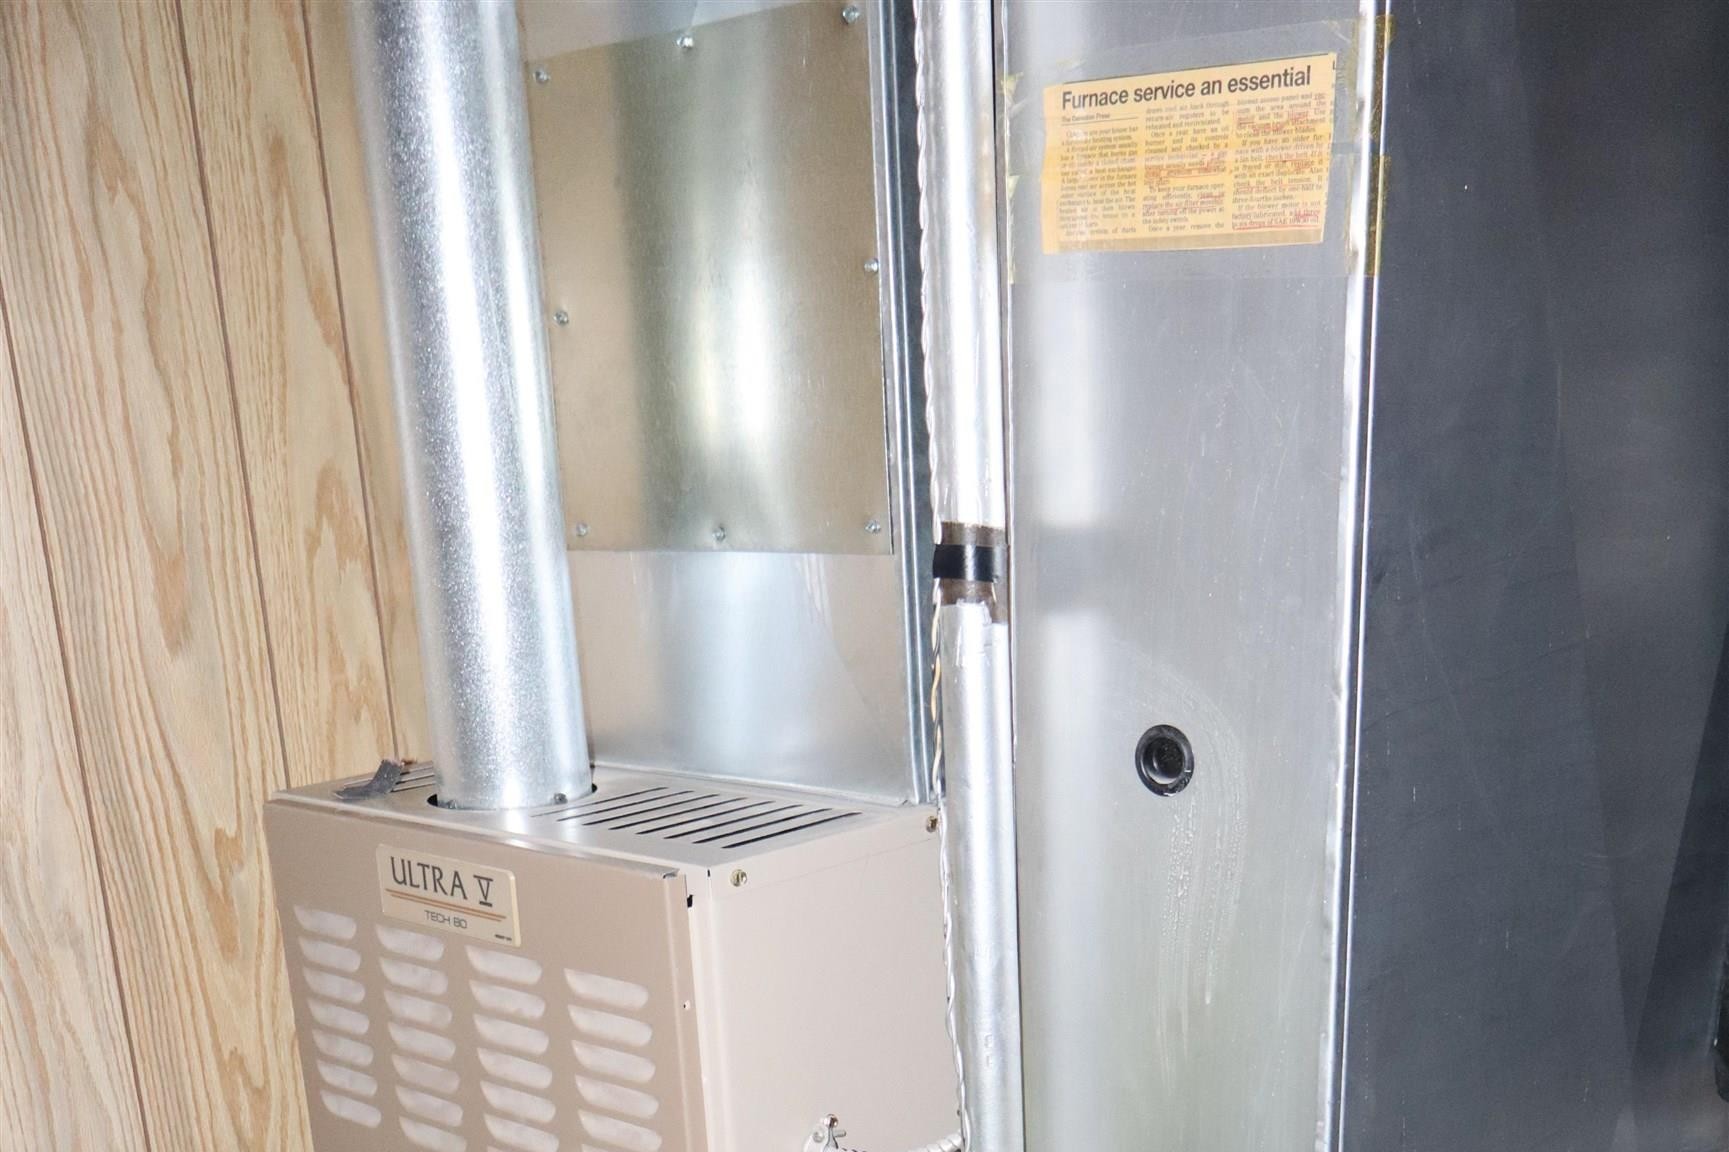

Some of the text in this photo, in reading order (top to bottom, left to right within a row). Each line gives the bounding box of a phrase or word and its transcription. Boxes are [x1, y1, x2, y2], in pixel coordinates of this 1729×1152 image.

[1062, 65, 1312, 110] Furnace service an essential
[391, 856, 493, 907] ULTRA V
[424, 910, 450, 924] TECH
